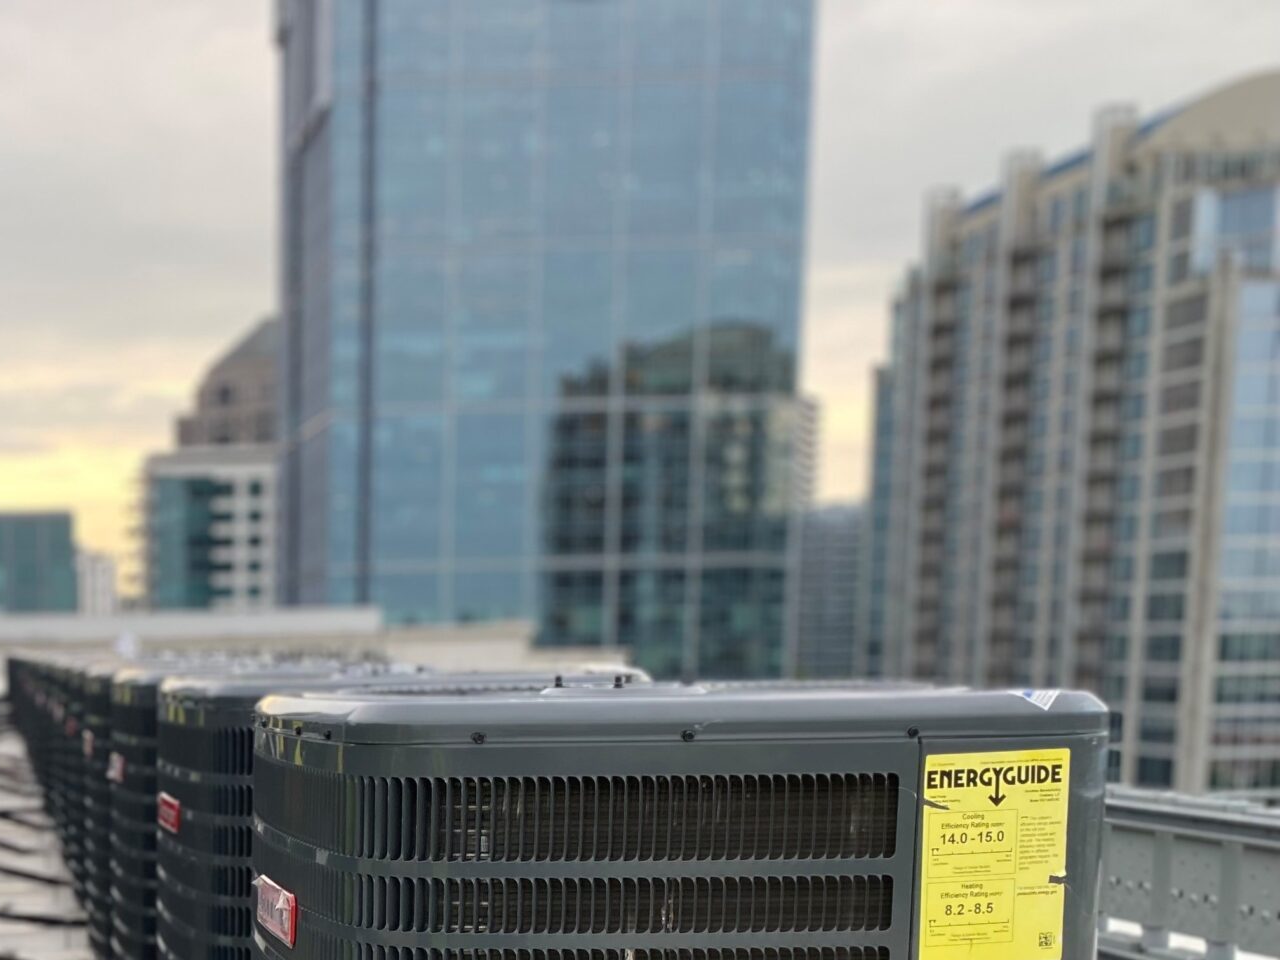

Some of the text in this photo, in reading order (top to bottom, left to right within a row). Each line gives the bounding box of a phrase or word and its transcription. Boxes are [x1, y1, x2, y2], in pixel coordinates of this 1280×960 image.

[926, 764, 1063, 790] ENERGYGUIDE
[962, 813, 985, 821] Cooling
[941, 822, 969, 830] Efficiency
[971, 821, 990, 829] Rating
[961, 882, 983, 890] Heating
[940, 891, 968, 899] Efficiency
[970, 890, 988, 898] Rating
